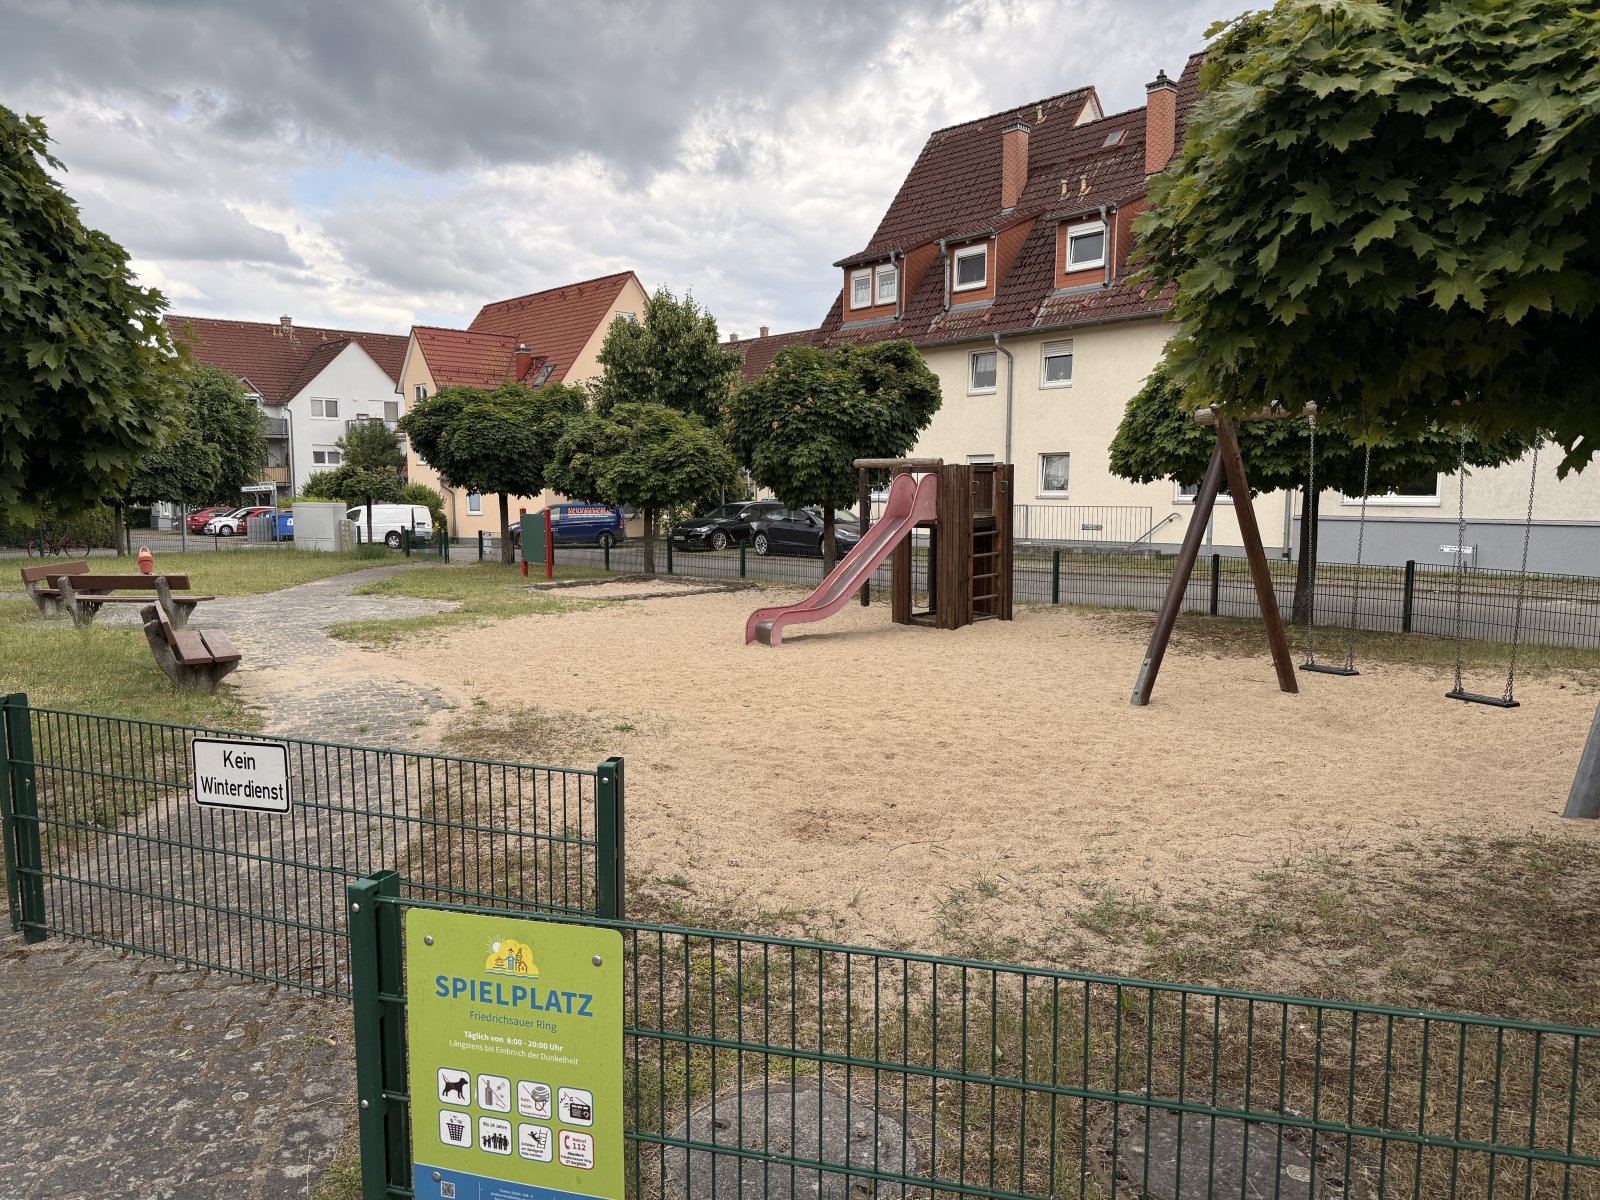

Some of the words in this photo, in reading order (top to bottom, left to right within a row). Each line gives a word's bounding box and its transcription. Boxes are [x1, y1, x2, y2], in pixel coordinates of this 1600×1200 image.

[223, 749, 256, 770] Kein
[200, 775, 284, 801] Winterdienst
[435, 974, 593, 1017] SPIELPLATZ
[469, 1010, 534, 1029] Friedrichsauer
[536, 1019, 557, 1033] Ring
[449, 1039, 483, 1051] Längstens
[484, 1044, 495, 1052] bis
[495, 1046, 526, 1057] Einbruch
[527, 1050, 539, 1059] der
[540, 1053, 579, 1065] Dunkelheit
[463, 1030, 490, 1042] Täglich
[506, 1037, 523, 1046] 8:00
[527, 1040, 548, 1050] 20:00
[549, 1043, 564, 1052] Uhr
[572, 1142, 587, 1151] 112
